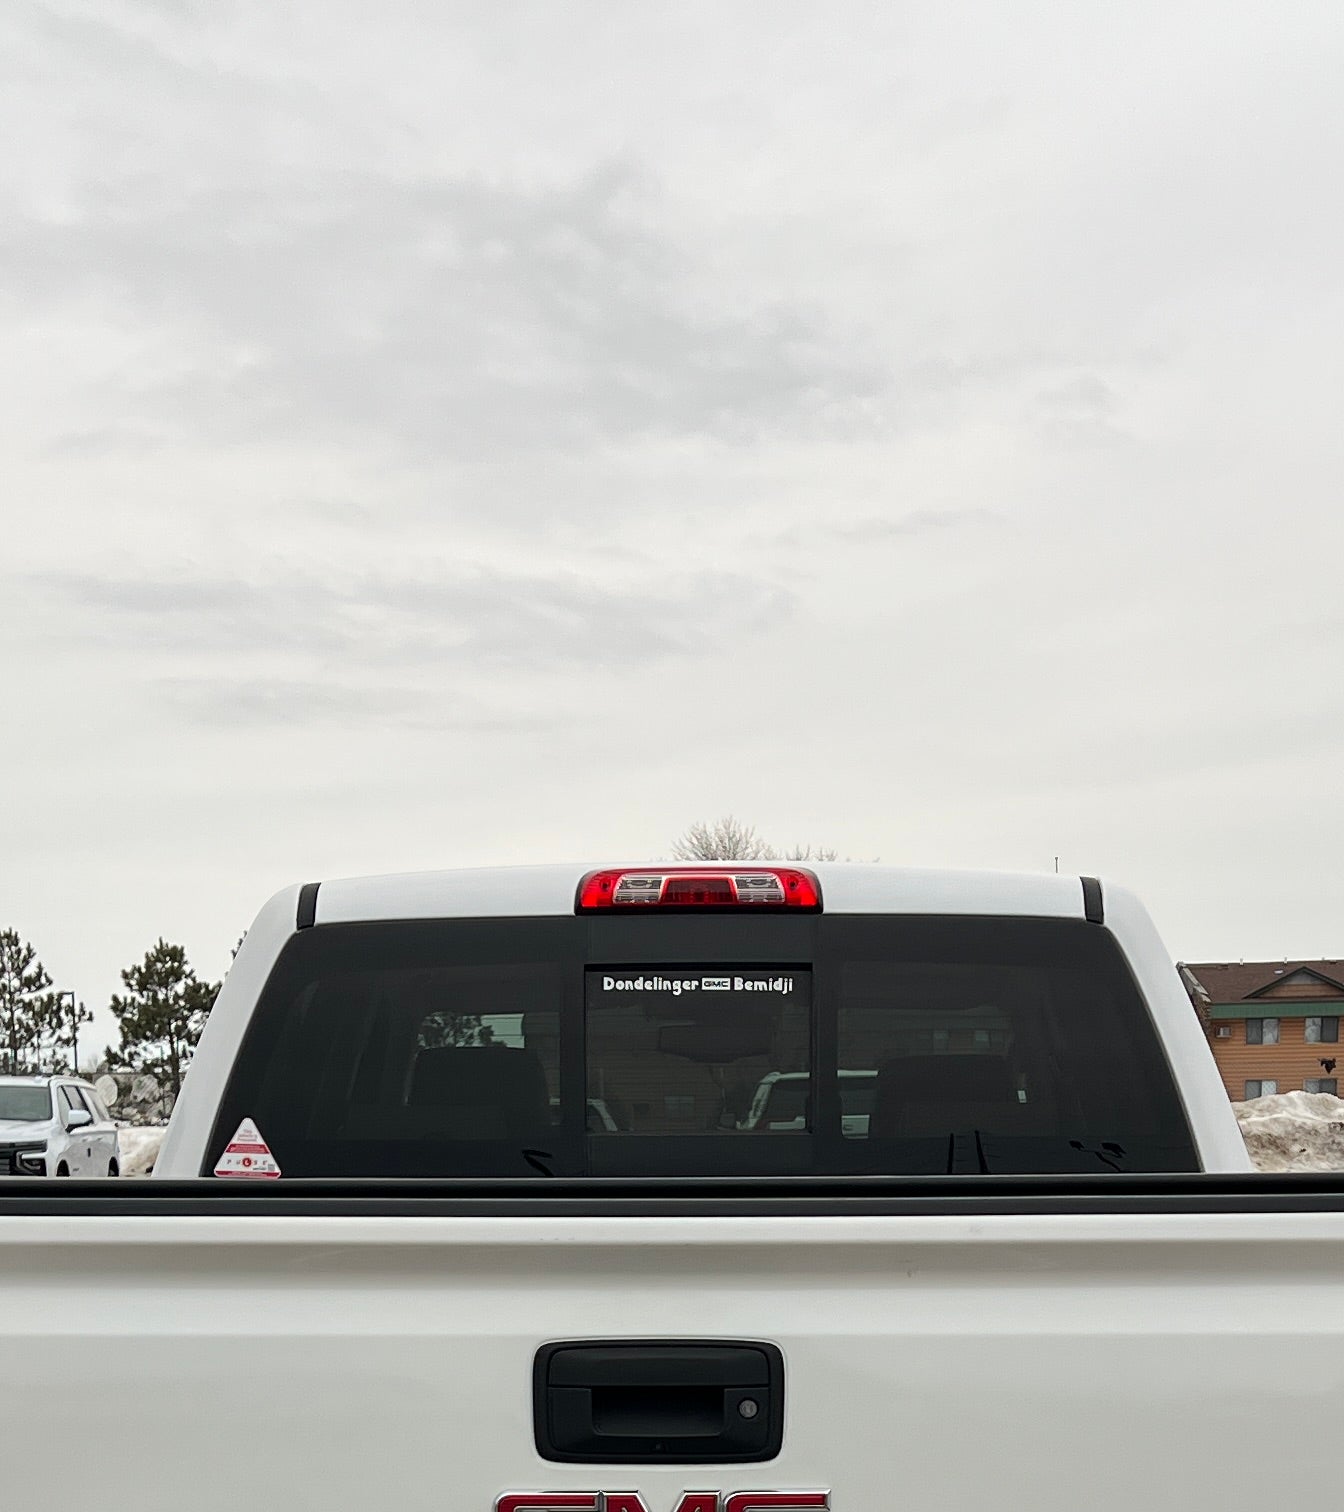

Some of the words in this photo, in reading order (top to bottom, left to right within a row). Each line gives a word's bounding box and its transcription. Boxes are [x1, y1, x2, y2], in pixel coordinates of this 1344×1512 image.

[603, 977, 699, 995] Dondelinger
[703, 980, 729, 988] GMC
[733, 977, 793, 994] Bemidji
